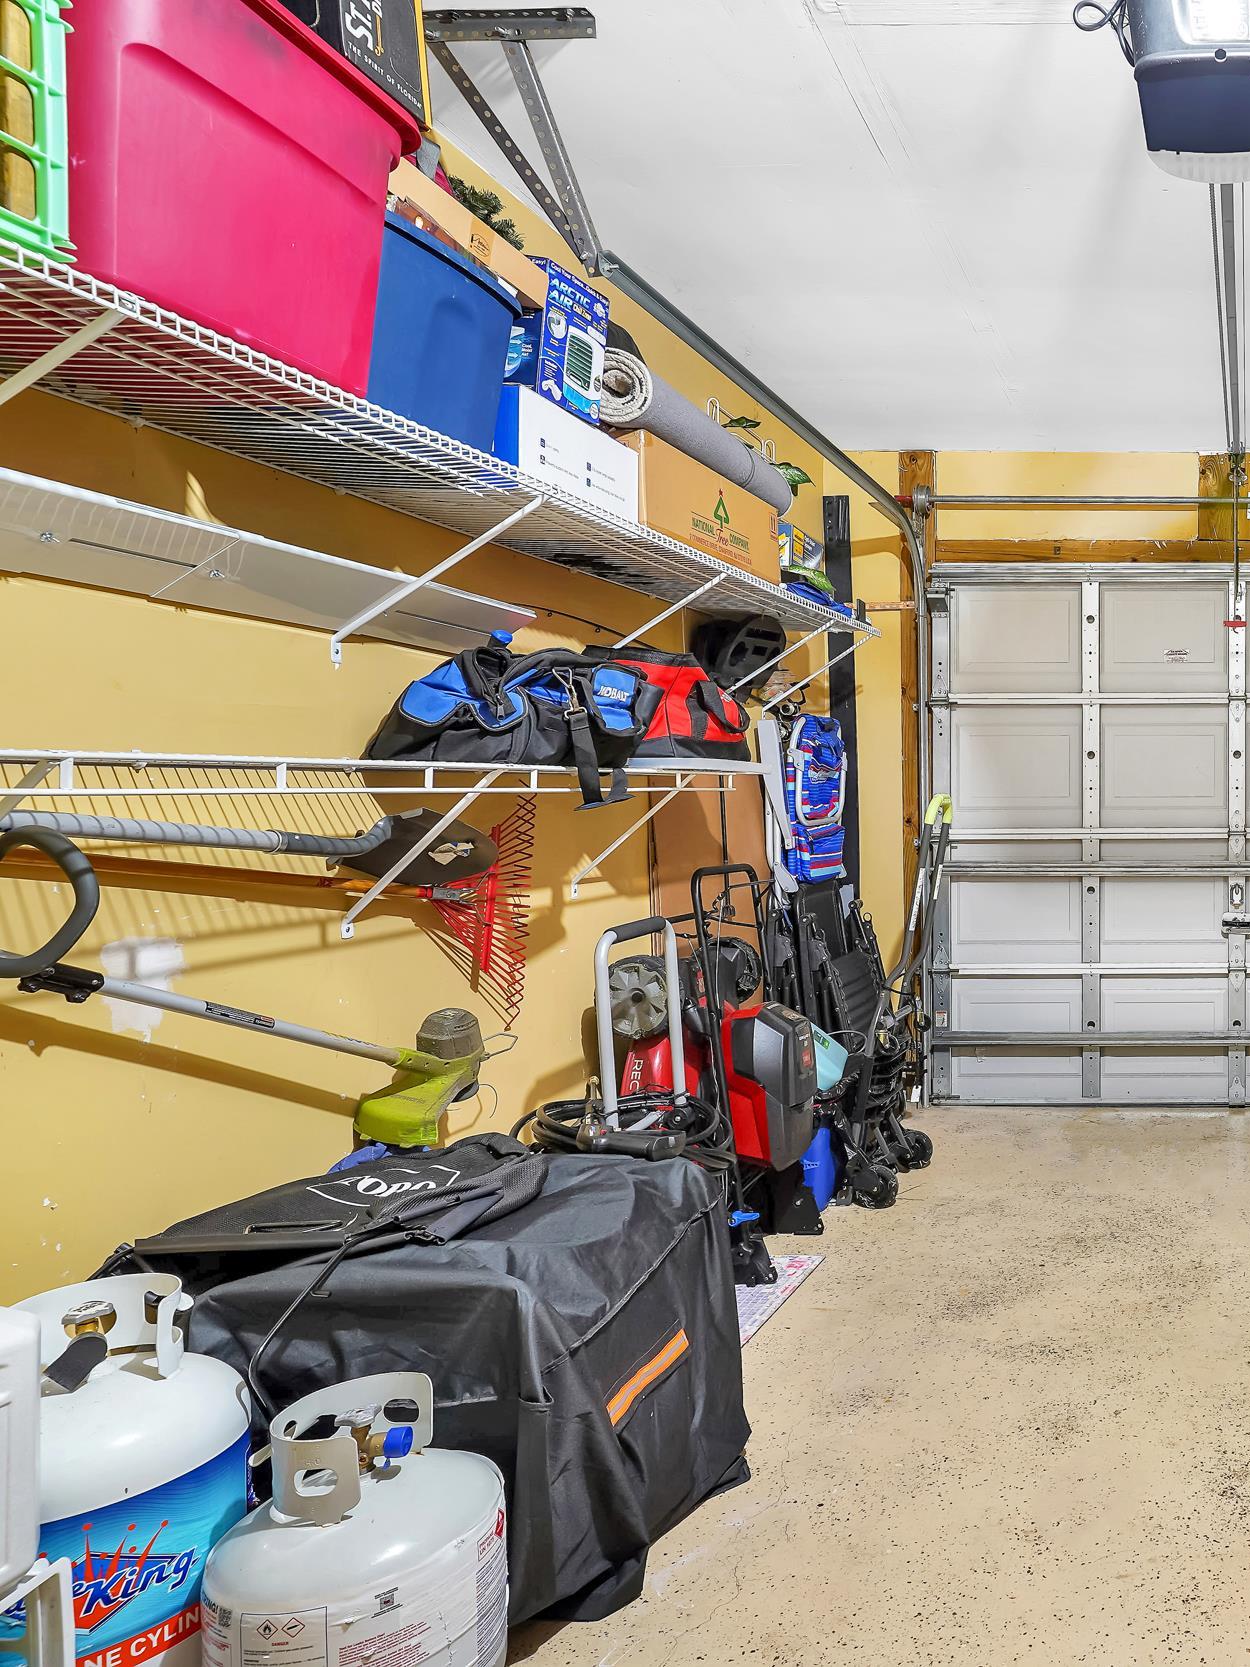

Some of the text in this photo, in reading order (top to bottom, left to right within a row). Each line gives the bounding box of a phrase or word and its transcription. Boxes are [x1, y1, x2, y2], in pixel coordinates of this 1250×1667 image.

[347, 41, 361, 57] THE
[363, 55, 384, 76] SPIRIT
[386, 74, 395, 85] OF
[548, 289, 573, 311] AIR
[549, 278, 590, 309] ARCTIC
[691, 517, 716, 536] NATIONAL
[715, 528, 729, 547] Tree
[729, 533, 750, 551] COMPANY
[597, 685, 630, 702] KOBALT
